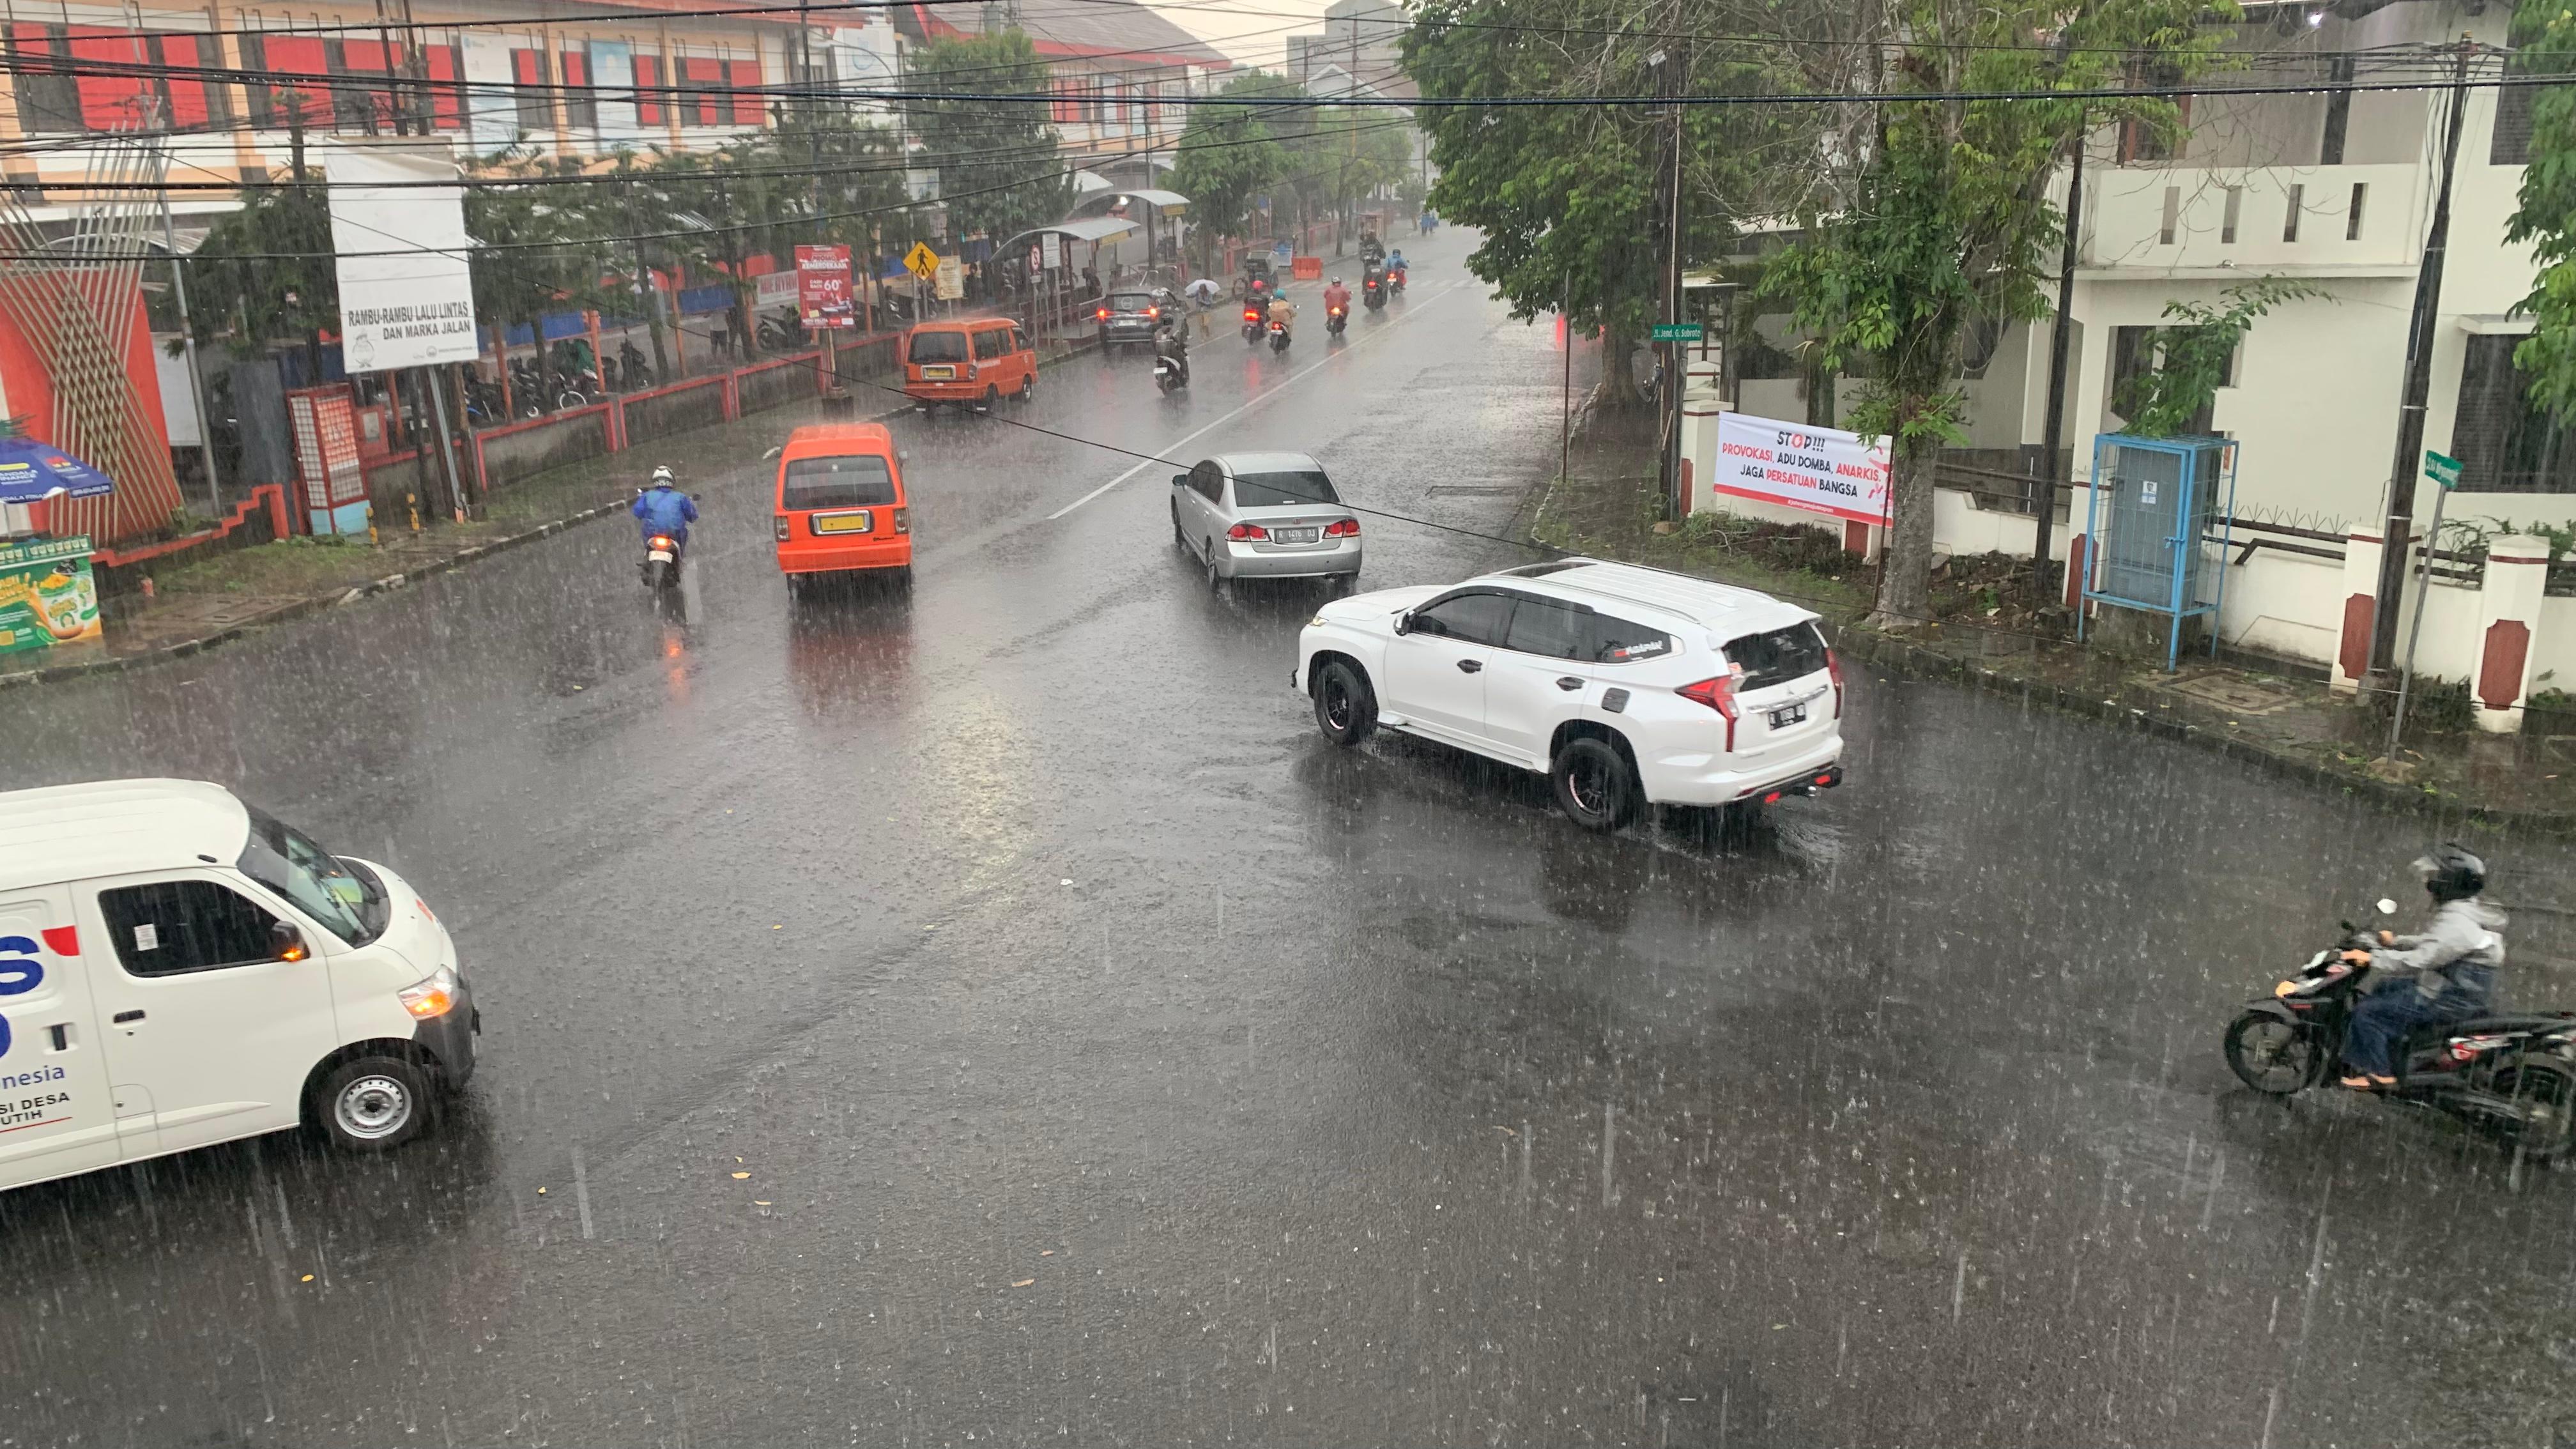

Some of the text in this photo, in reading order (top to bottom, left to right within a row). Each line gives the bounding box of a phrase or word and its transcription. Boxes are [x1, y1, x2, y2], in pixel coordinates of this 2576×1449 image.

[348, 301, 468, 326] RAMBU-RAMBU LALU LINTAS
[383, 320, 471, 340] DAN MARKA JALAN
[1681, 328, 1701, 337] Subroto
[1777, 431, 1825, 452] STOP!!!
[1722, 442, 1775, 464] PROVOKASI,
[1777, 452, 1795, 466] ADU
[1798, 457, 1834, 475] DOMBA,
[1740, 464, 1858, 497] JAGA PERSATUAN BANGSA
[1, 1065, 65, 1089] nesia
[21, 1092, 70, 1110] DESA
[1, 1109, 42, 1125] UTIH
